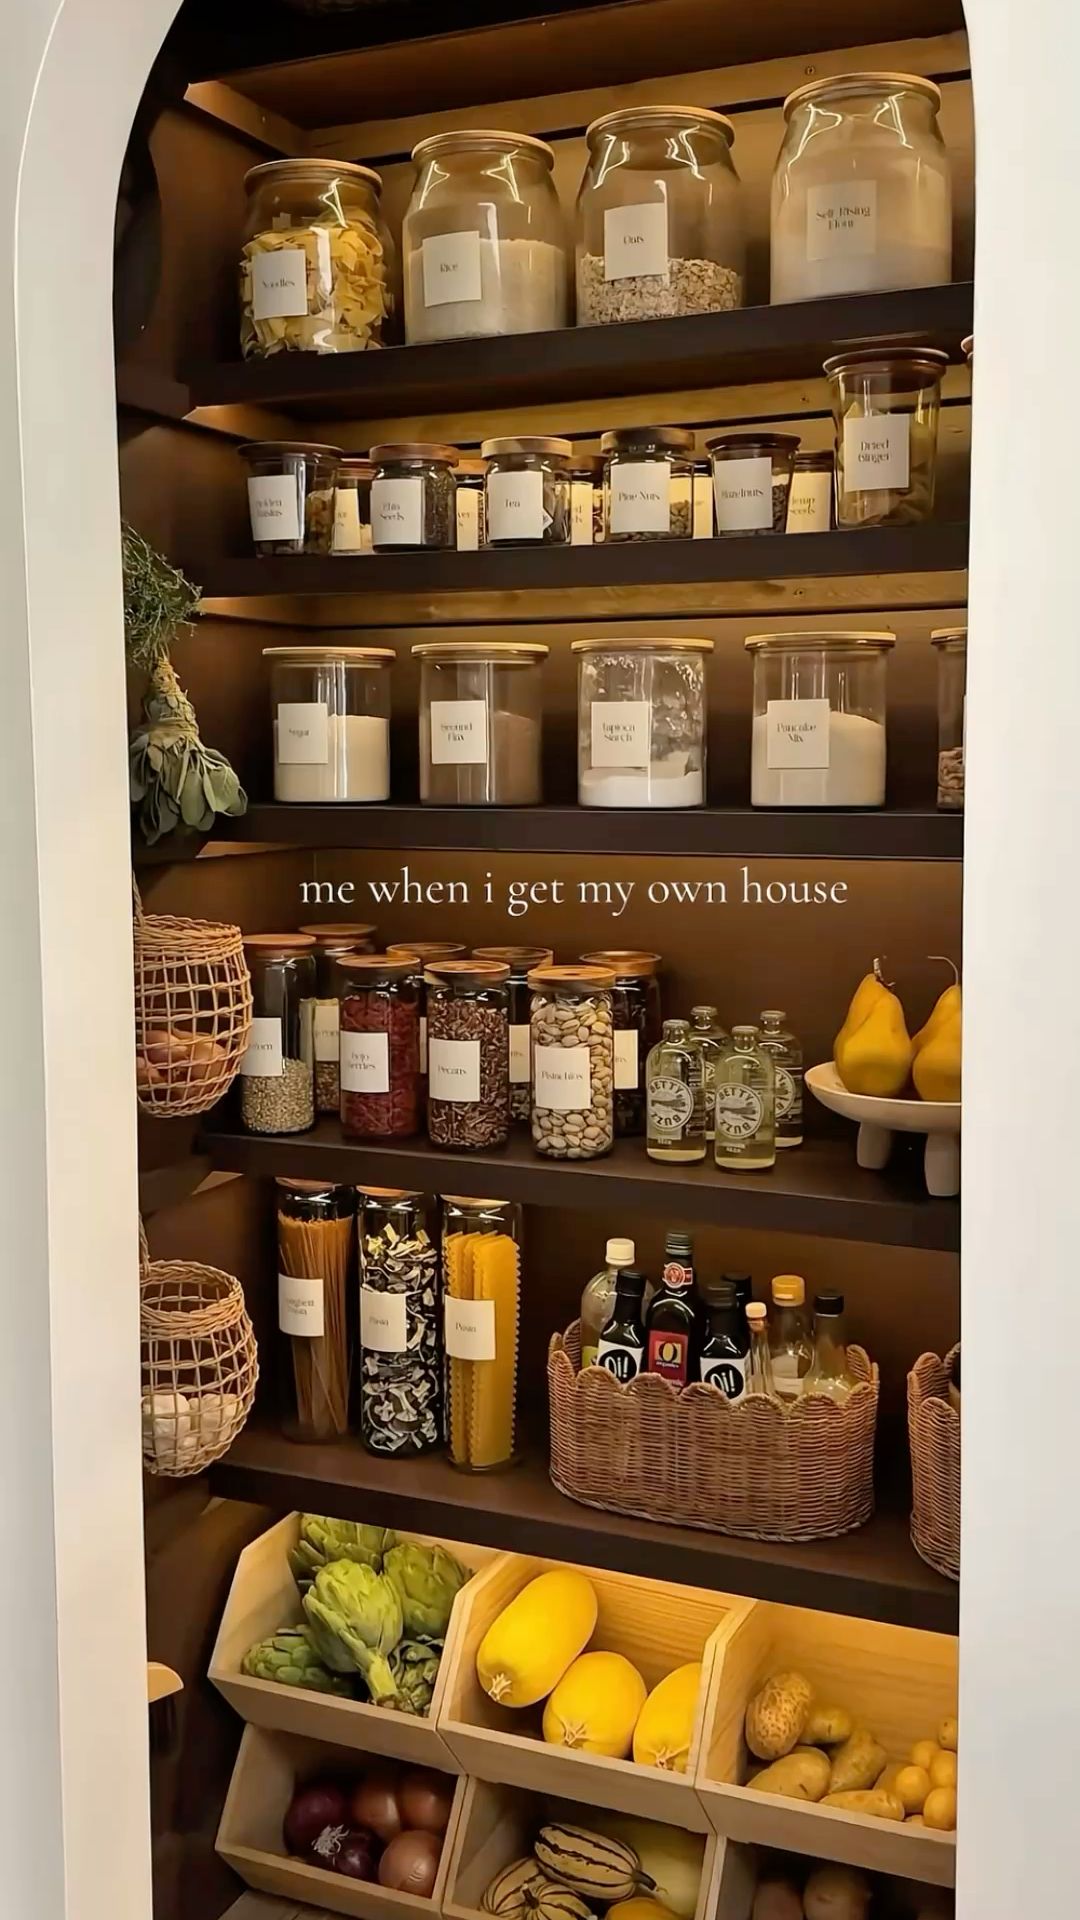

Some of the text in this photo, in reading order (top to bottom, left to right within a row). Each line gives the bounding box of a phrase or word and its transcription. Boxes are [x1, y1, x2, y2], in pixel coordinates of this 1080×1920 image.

[623, 234, 645, 245] Oats
[440, 262, 459, 273] Rice
[262, 277, 296, 288] Noodles
[861, 438, 889, 450] Dried
[858, 452, 889, 464] Ginger
[720, 487, 764, 499] Hazelnuts
[602, 722, 635, 734] Tapioca
[776, 722, 817, 733] Pancake
[437, 1064, 467, 1077] Pecans
[541, 1069, 584, 1081] Pistachios
[650, 1080, 685, 1094] BETTY
[718, 1086, 755, 1101] BETTY
[720, 1118, 751, 1134] BUZZ
[455, 1321, 477, 1333] Pasta
